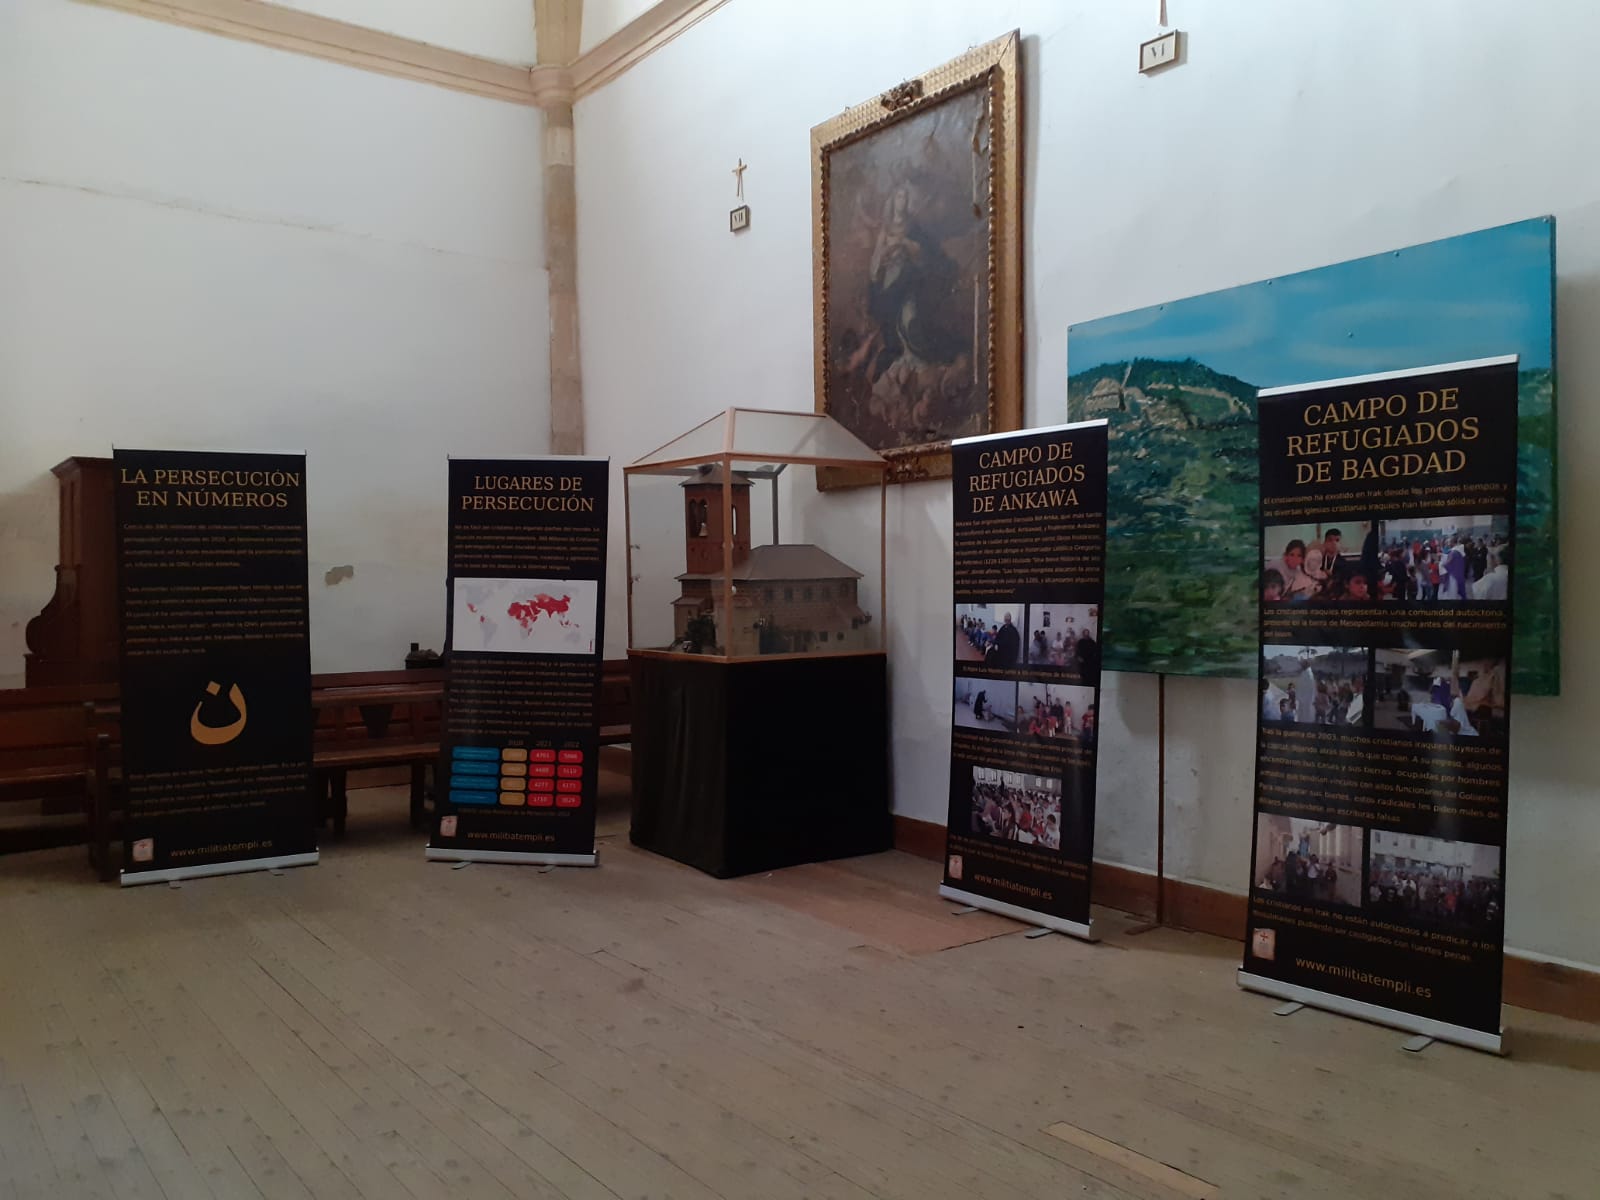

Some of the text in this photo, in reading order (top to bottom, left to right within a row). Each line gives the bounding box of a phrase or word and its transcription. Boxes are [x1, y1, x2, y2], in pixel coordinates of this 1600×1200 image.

[1304, 387, 1459, 427] CAMPO DE
[1287, 416, 1480, 457] REFUGIADOS
[979, 442, 1073, 470] CAMPO DE
[1296, 449, 1466, 484] DE BAGDAD
[120, 468, 299, 487] LA PERSECUCIÓN
[474, 476, 582, 491] LUGARES DE
[969, 464, 1085, 492] REFUGIADOS
[136, 488, 288, 508] EN NÚMEROS
[462, 494, 594, 512] PERSECUCIÓN
[972, 488, 1079, 513] DE ANKAWA
[1341, 735, 1371, 744] muchos
[171, 840, 272, 857] www.militiatempli.es
[974, 873, 1053, 900] www.militiatempli.es
[1296, 956, 1432, 999] www.militiatempli.es
